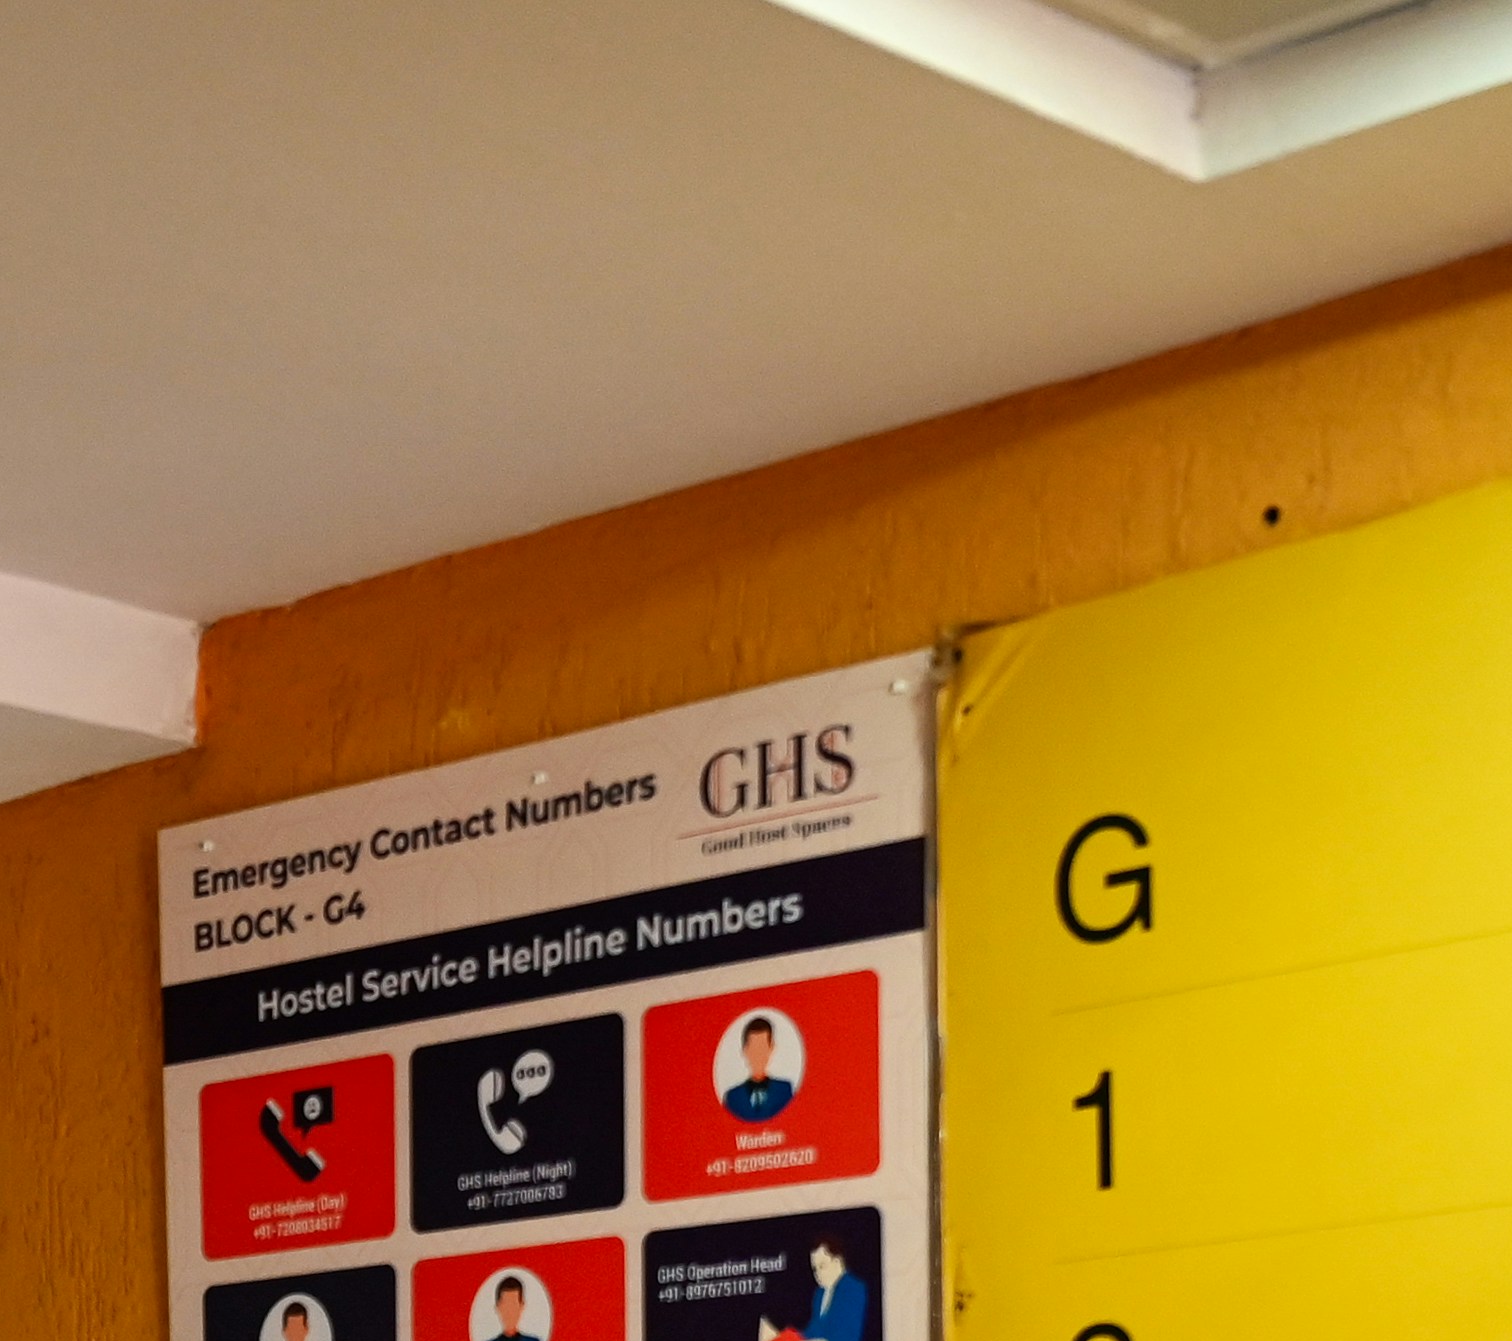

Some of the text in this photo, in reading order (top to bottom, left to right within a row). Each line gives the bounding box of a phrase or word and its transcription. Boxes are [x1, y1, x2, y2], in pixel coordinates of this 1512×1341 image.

[699, 724, 855, 818] GHS
[193, 769, 658, 898] Emergency Contact Numbers
[1055, 814, 1153, 945] G
[194, 904, 296, 953] BLOCK
[324, 891, 366, 929] G4
[258, 890, 804, 1023] Hostel Service Helpline Numbers
[736, 1131, 785, 1149] Warden
[1072, 1070, 1114, 1191] 1
[249, 1193, 345, 1221] GHS Helpline (Day)
[457, 1160, 573, 1191] GHS Helpline (Night)
[658, 1253, 786, 1284] GHS Operation Head
